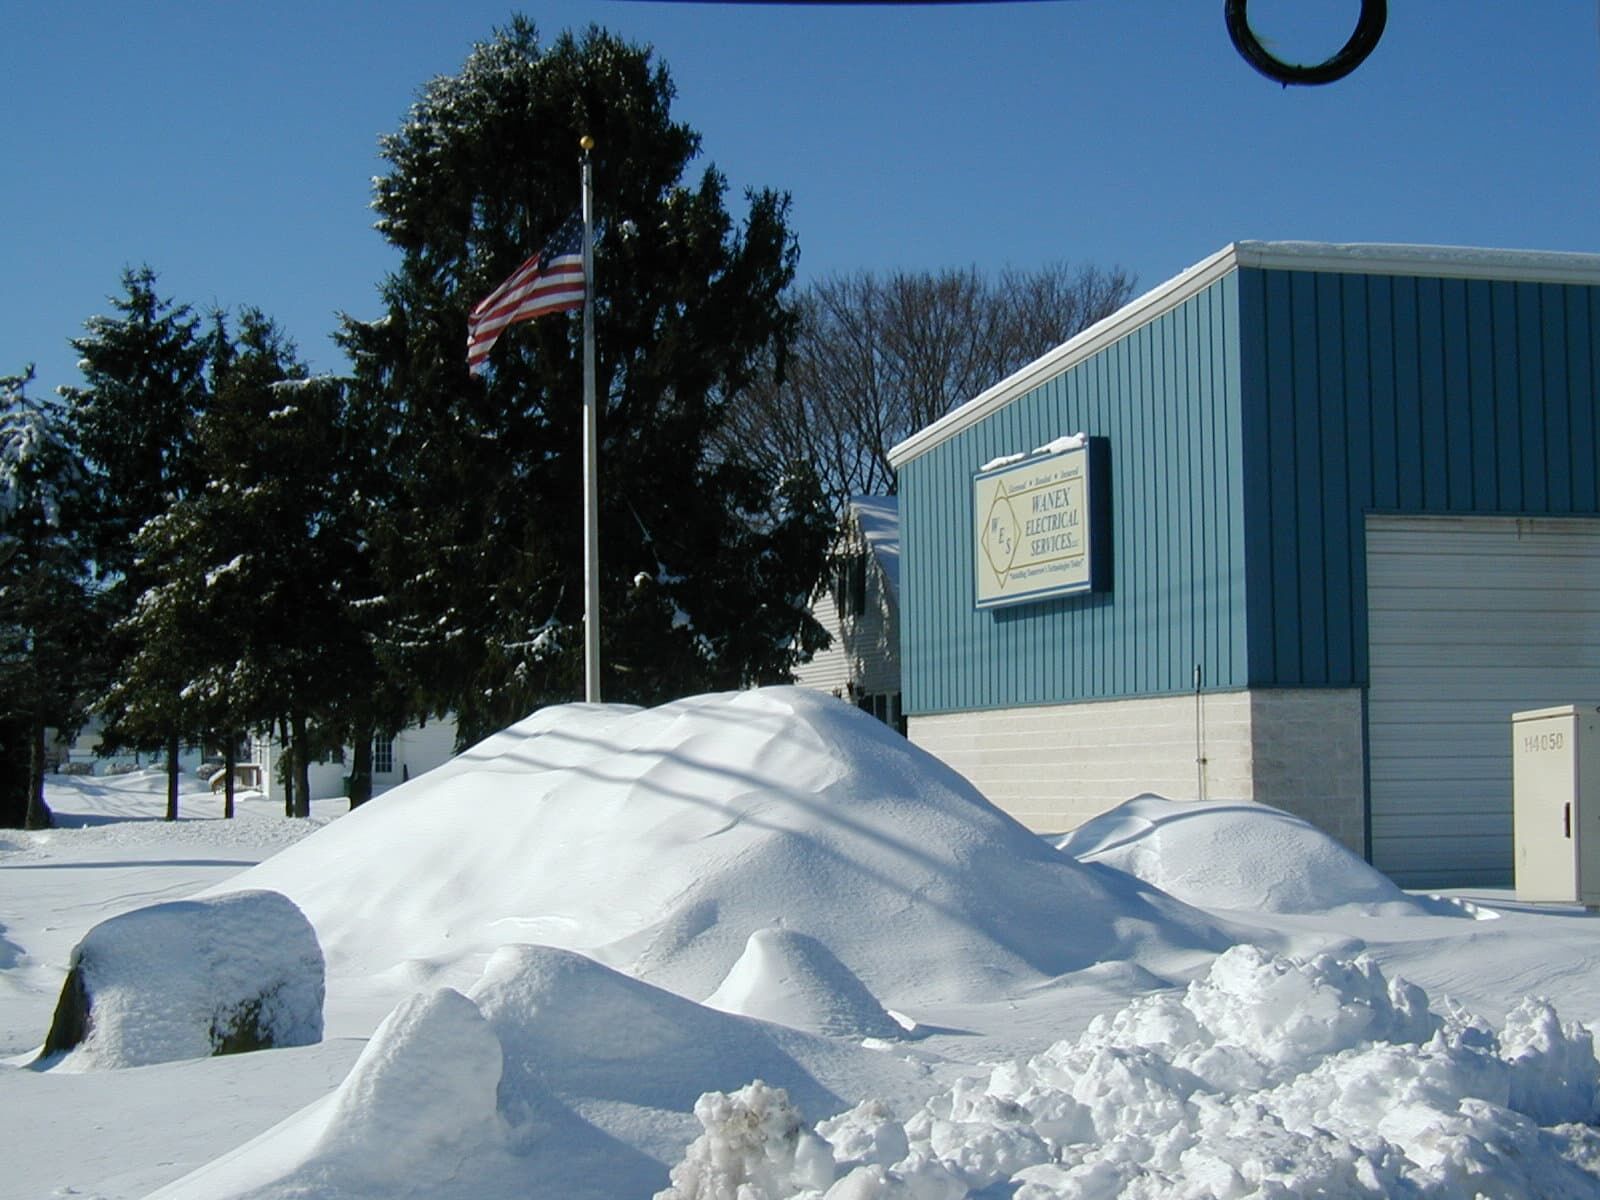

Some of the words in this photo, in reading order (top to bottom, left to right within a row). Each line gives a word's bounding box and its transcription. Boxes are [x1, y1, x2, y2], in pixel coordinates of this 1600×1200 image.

[1032, 488, 1071, 513] WANEX
[1026, 509, 1079, 536] ELECTRICAL
[1031, 533, 1072, 556] SERVICES
